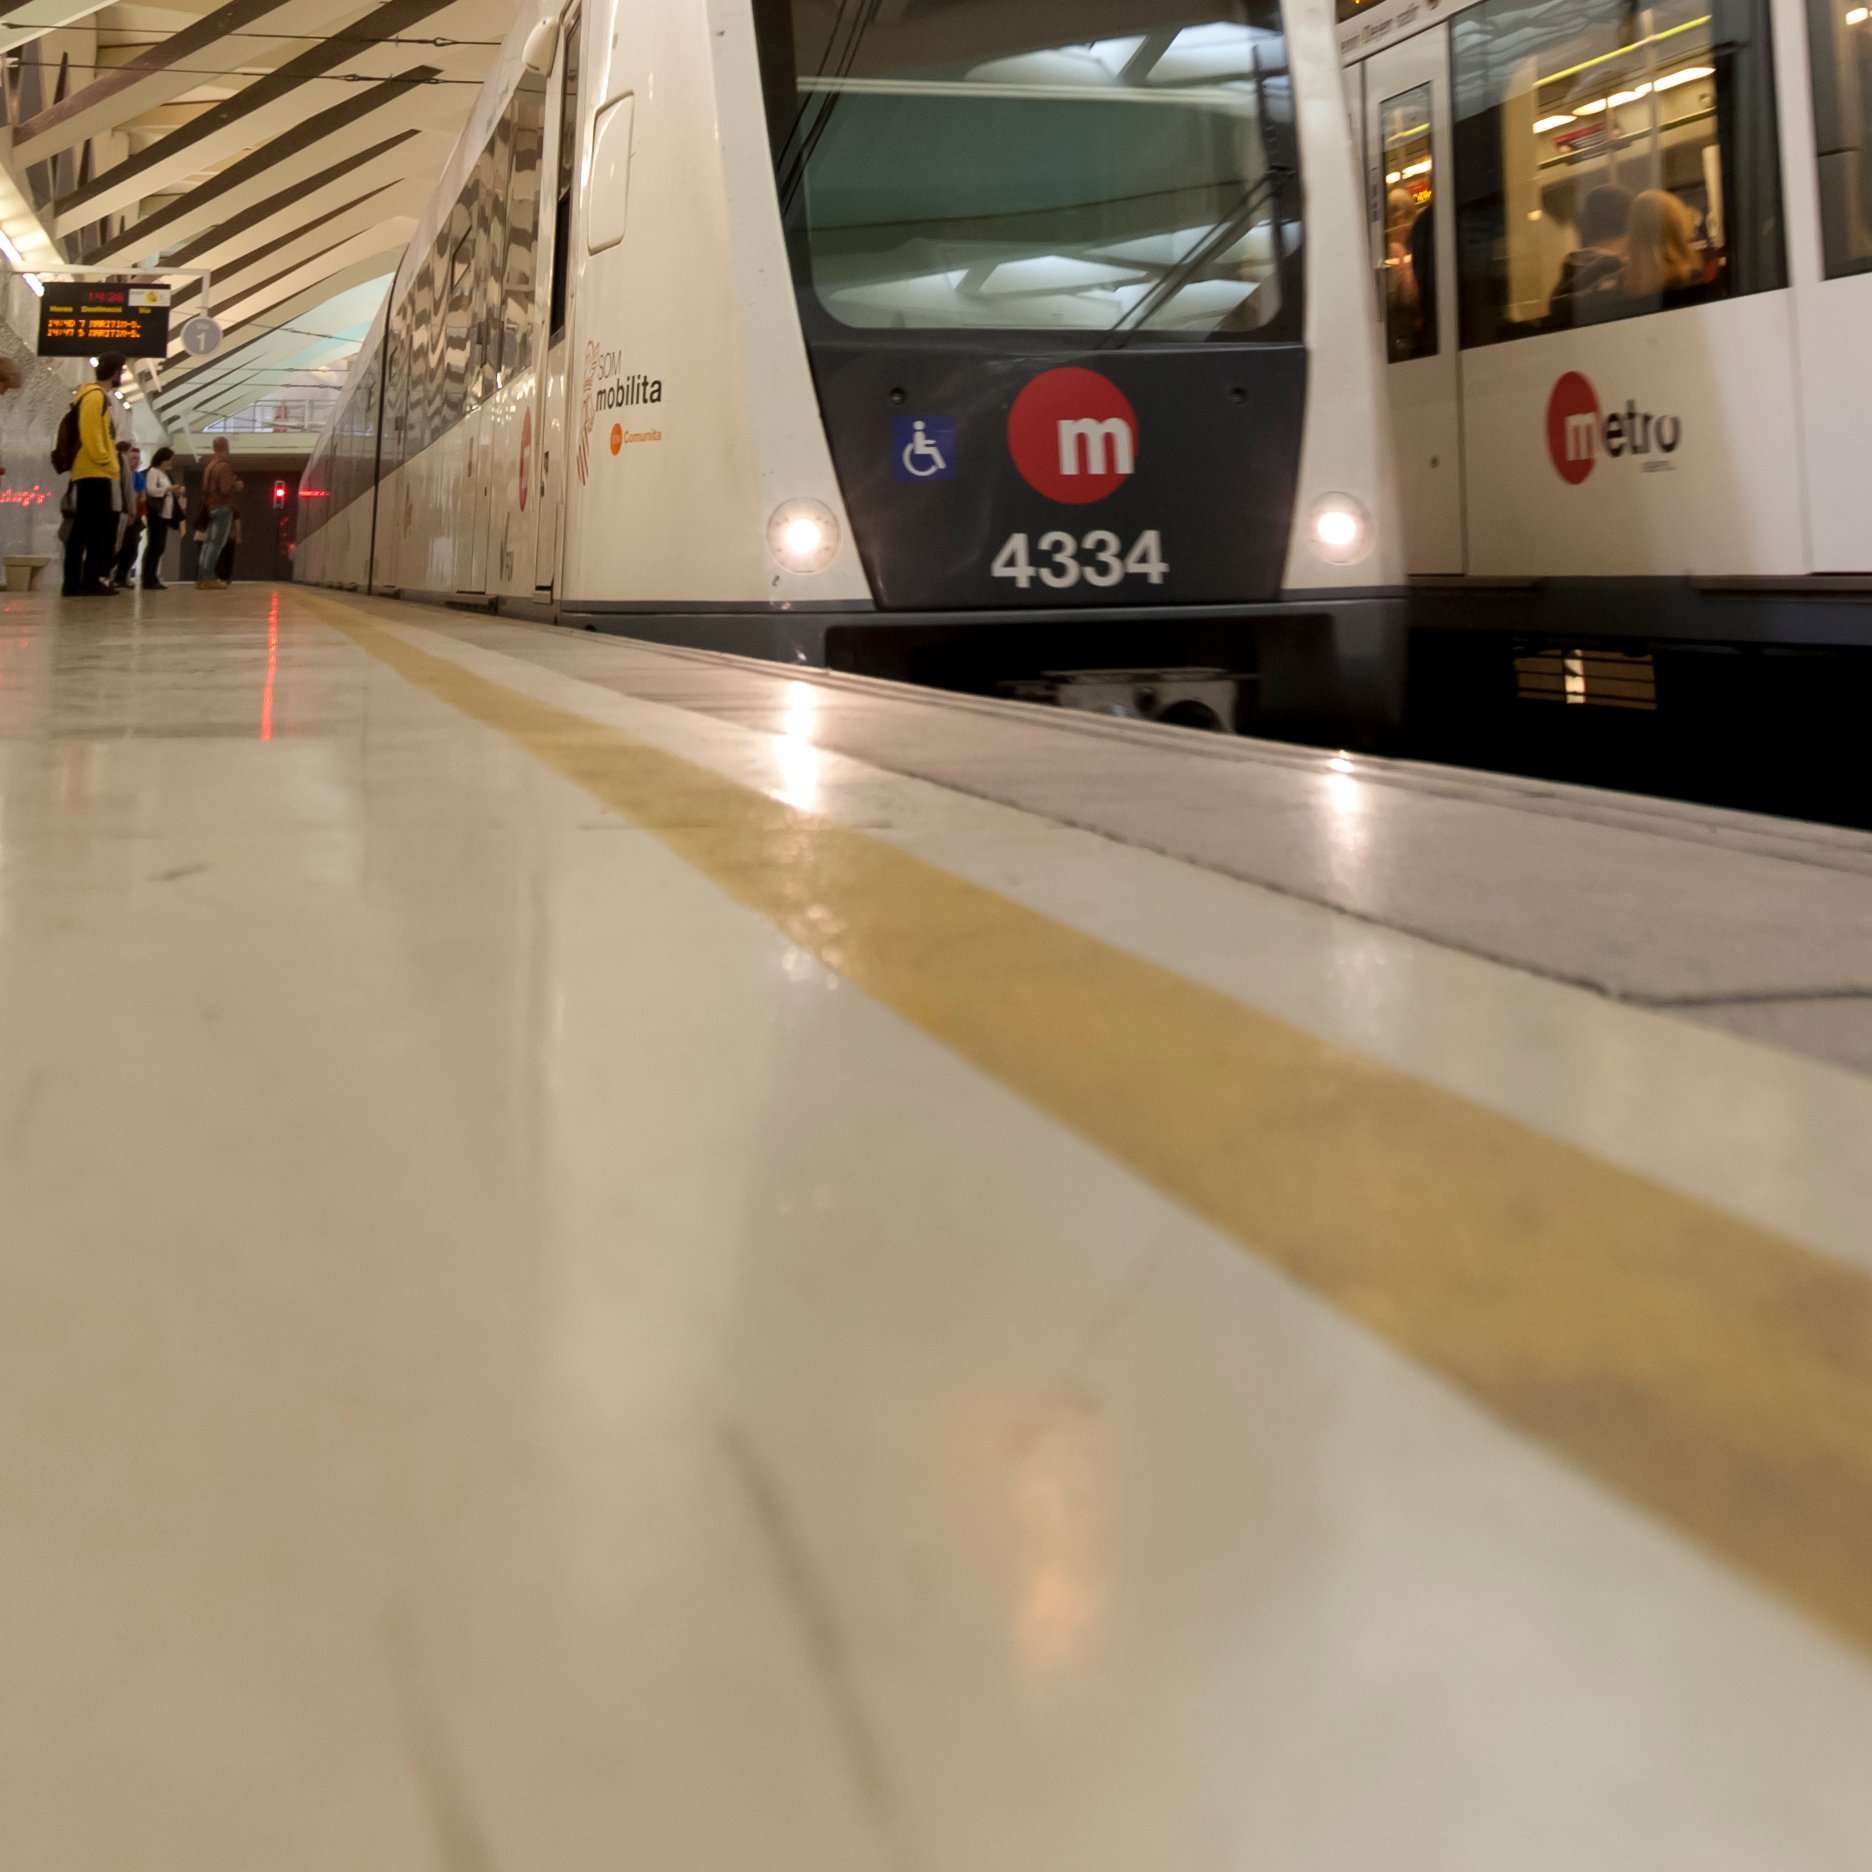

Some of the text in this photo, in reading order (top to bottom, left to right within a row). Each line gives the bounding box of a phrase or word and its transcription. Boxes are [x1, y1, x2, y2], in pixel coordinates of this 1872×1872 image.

[196, 332, 206, 351] 1
[597, 350, 622, 380] SOM
[596, 374, 662, 412] mobilita
[991, 530, 1169, 589] 4334
